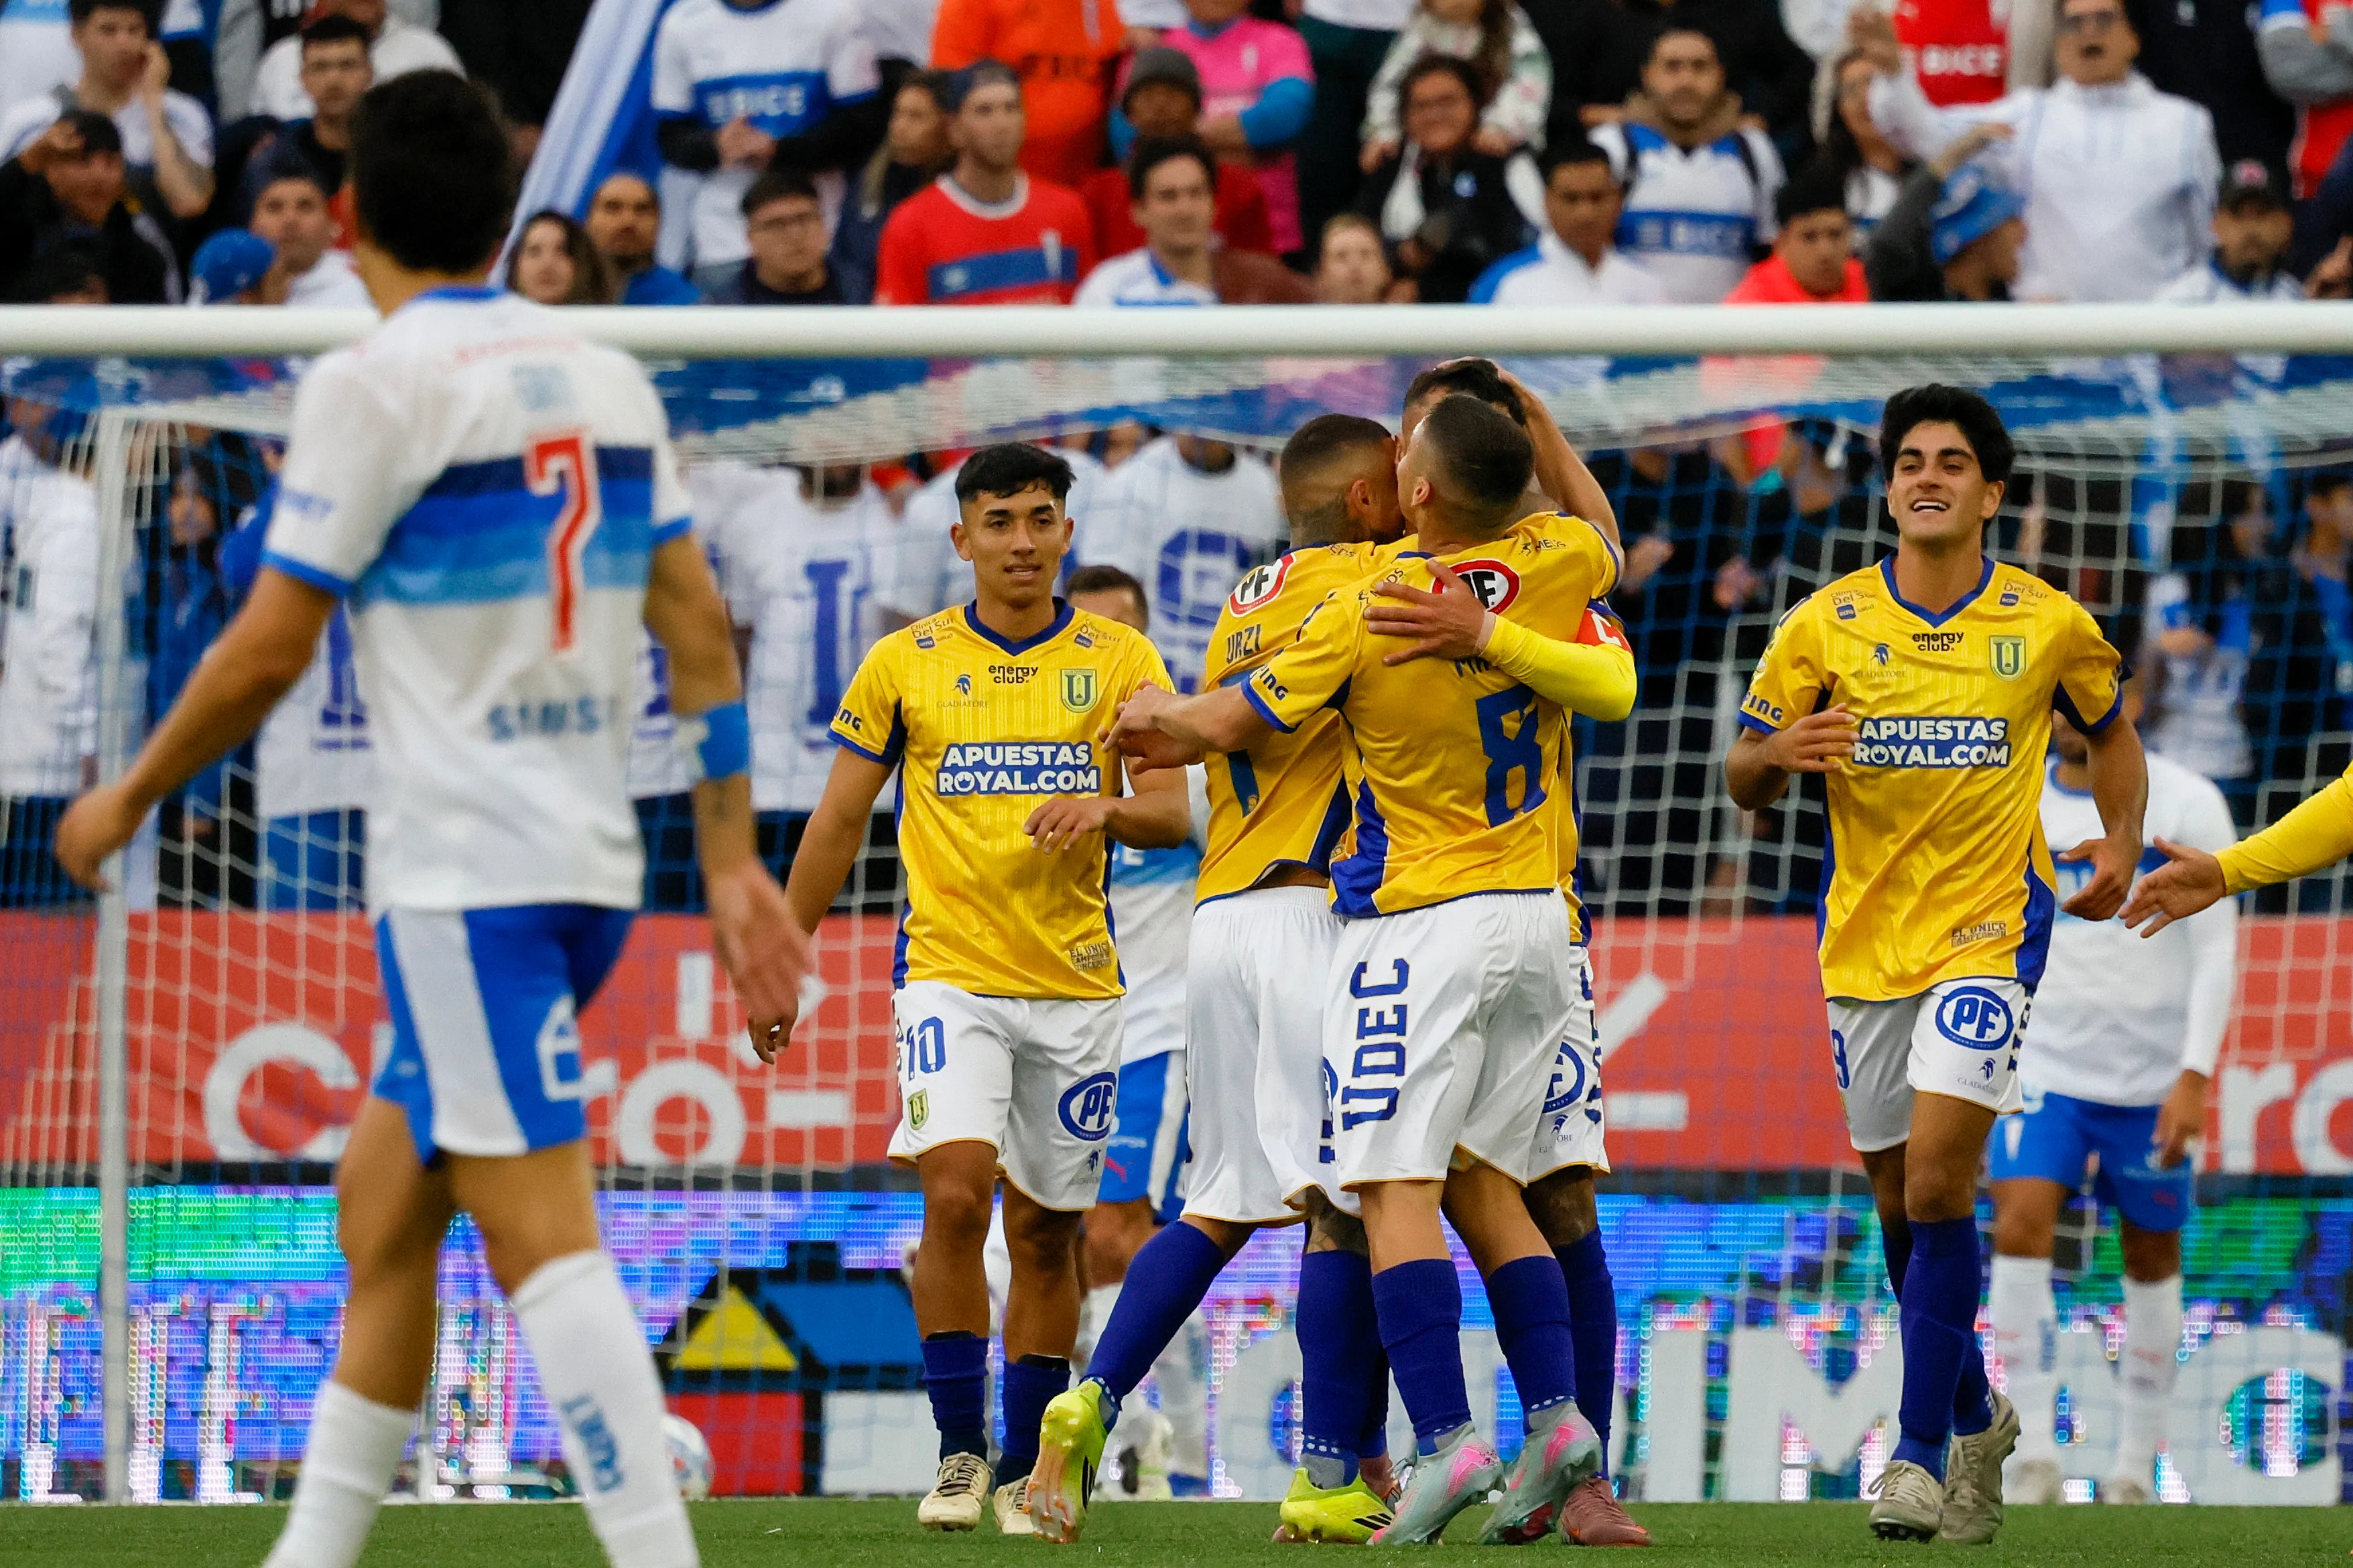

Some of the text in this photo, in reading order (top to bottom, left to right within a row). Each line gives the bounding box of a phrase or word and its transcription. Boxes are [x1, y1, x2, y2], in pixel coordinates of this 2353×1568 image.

[528, 428, 596, 657] 7
[1832, 594, 1854, 606] Del
[912, 618, 954, 638] Del Sur
[1912, 632, 1964, 643] energy
[1226, 624, 1261, 664] URZI
[988, 665, 1038, 677] energy
[1861, 720, 2007, 741] APUESTAS
[944, 744, 1090, 767] APUESTAS
[1476, 682, 1547, 828] 8
[1854, 743, 2008, 766] ROYAL.COM
[938, 769, 1098, 793] ROYAL.COM
[1952, 996, 2001, 1039] PF
[906, 1016, 946, 1082] 10
[1340, 957, 1410, 1132] UDEC
[1078, 1084, 1113, 1129] PF
